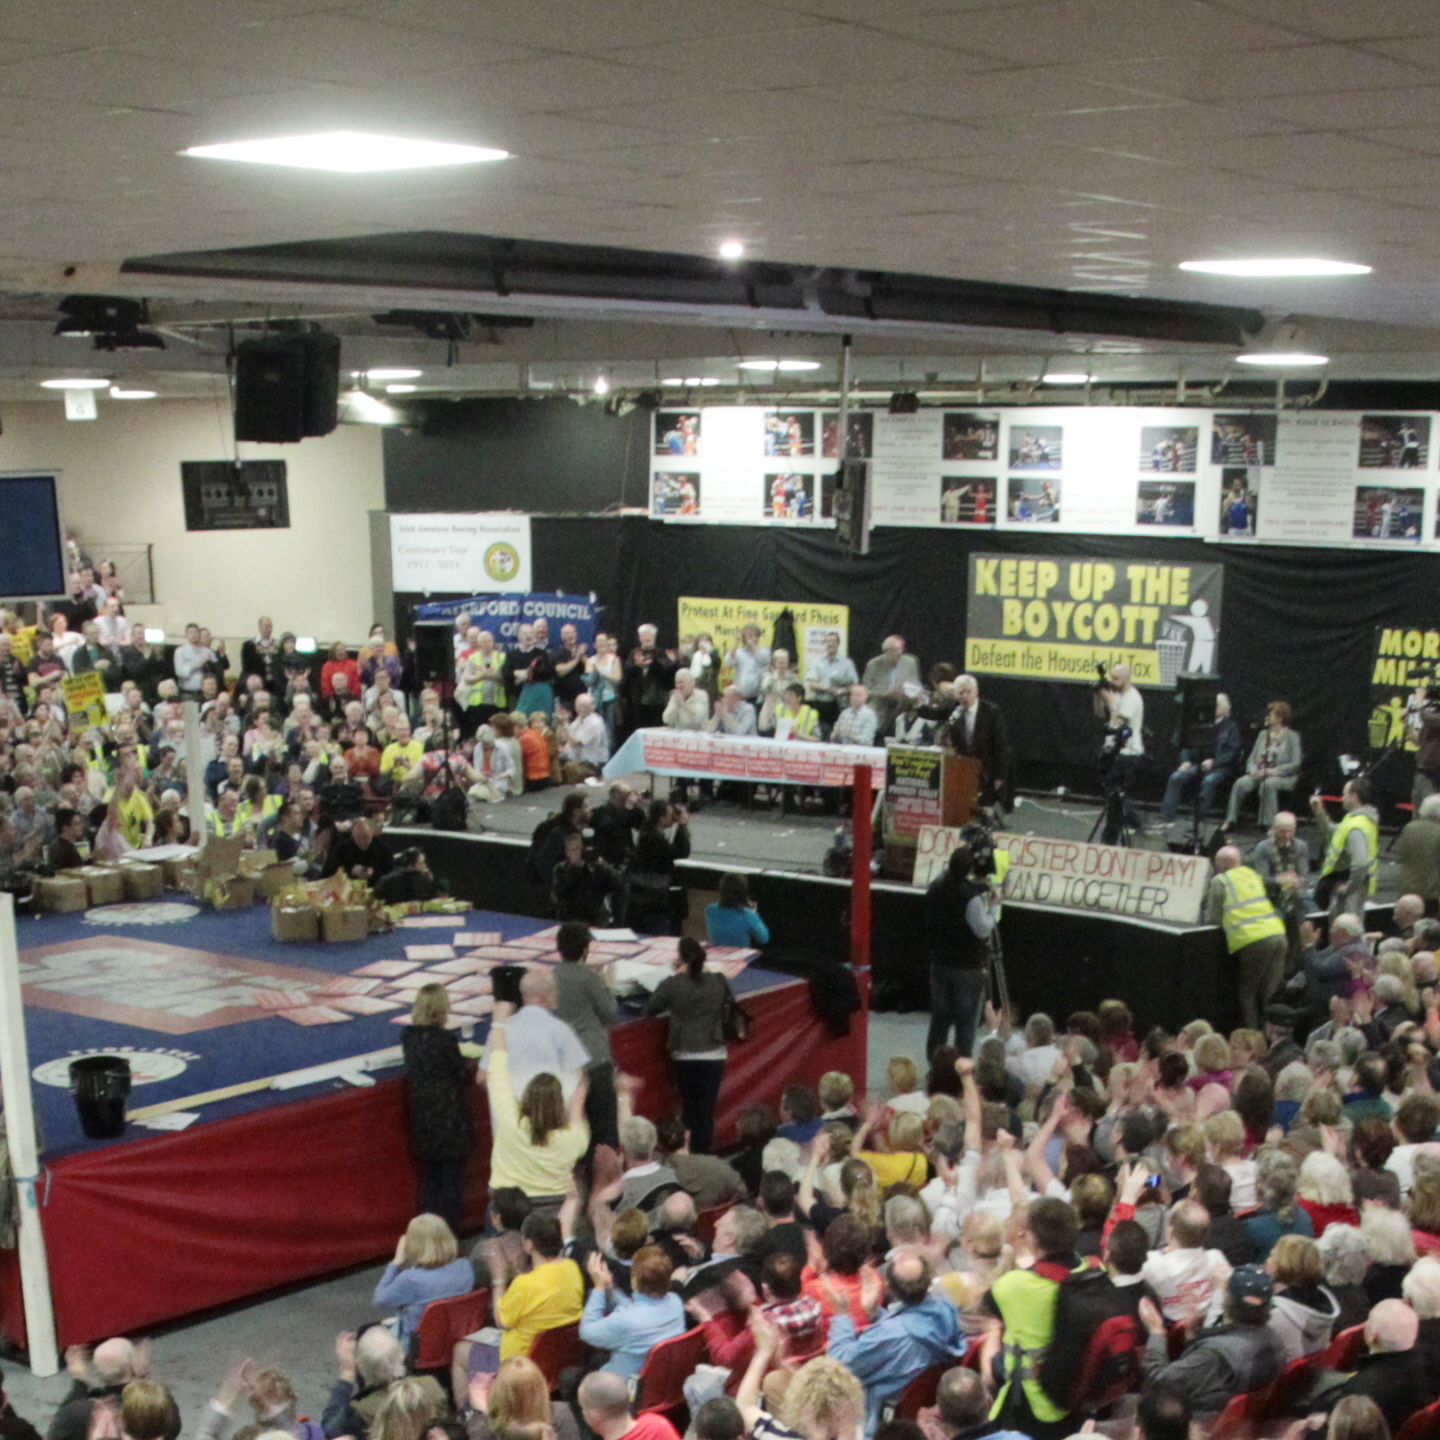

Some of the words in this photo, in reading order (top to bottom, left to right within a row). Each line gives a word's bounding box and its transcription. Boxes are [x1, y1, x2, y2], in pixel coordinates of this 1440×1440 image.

[399, 525, 415, 533] Irish
[452, 526, 477, 535] Boxing
[479, 526, 521, 534] Association
[398, 545, 446, 556] Centenary
[448, 545, 468, 555] Year
[975, 558, 1059, 598] KEEP
[1069, 562, 1116, 602] UP
[1127, 565, 1192, 606] THE
[441, 601, 520, 617] ATERFORD
[523, 601, 592, 620] COUNCIL
[681, 603, 718, 619] Protest
[723, 605, 733, 618] At
[737, 605, 758, 619] Fine
[810, 611, 839, 624] Fheis
[1003, 599, 1160, 644] BOYCOTT
[971, 645, 1017, 667] Defeat
[1021, 647, 1042, 669] the
[1127, 655, 1152, 678] Tax
[919, 827, 960, 856] DON
[996, 835, 1079, 874] EGISTER
[1083, 847, 1142, 881] DONT
[1148, 854, 1196, 888] PAY!
[1062, 876, 1170, 917] TOGETHER
